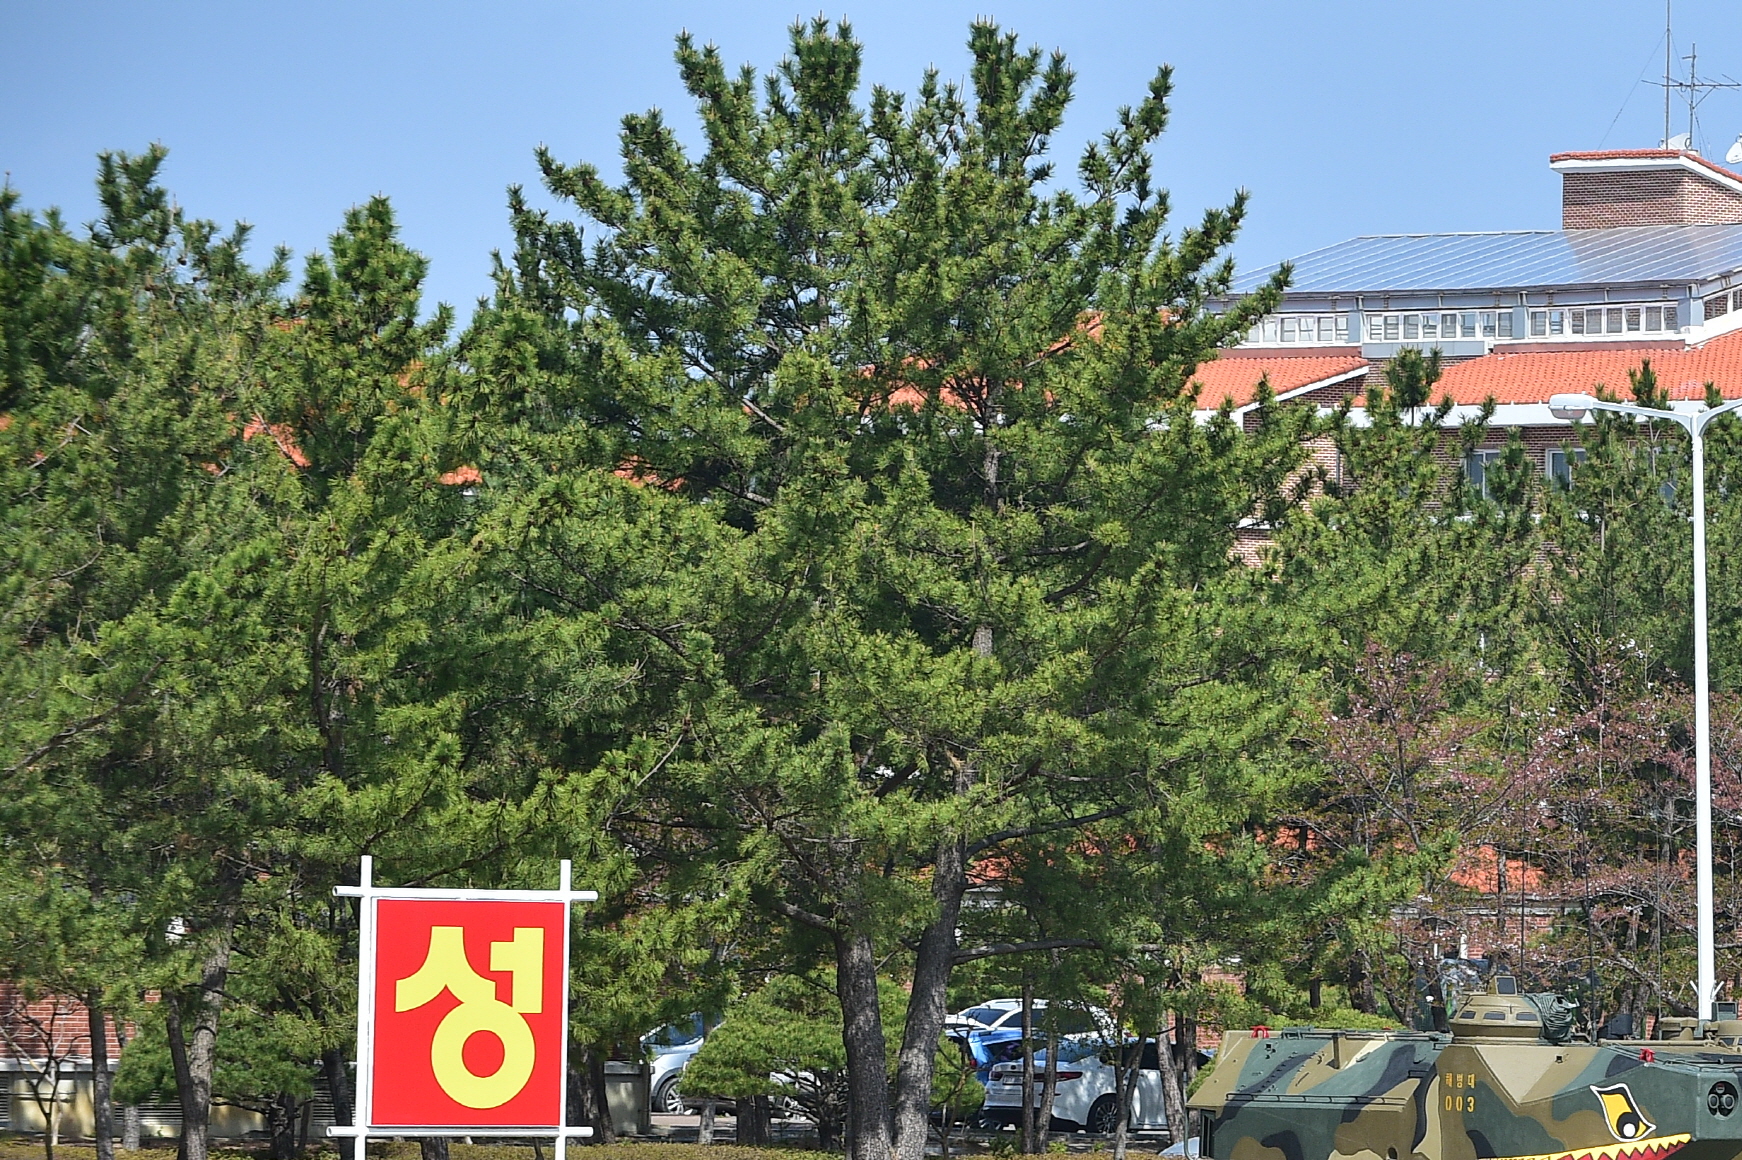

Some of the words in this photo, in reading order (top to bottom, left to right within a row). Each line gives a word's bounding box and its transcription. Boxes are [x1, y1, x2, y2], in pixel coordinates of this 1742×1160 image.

[395, 925, 544, 1109] 성
[1445, 1072, 1475, 1089] 해병대
[1445, 1095, 1475, 1112] 003
